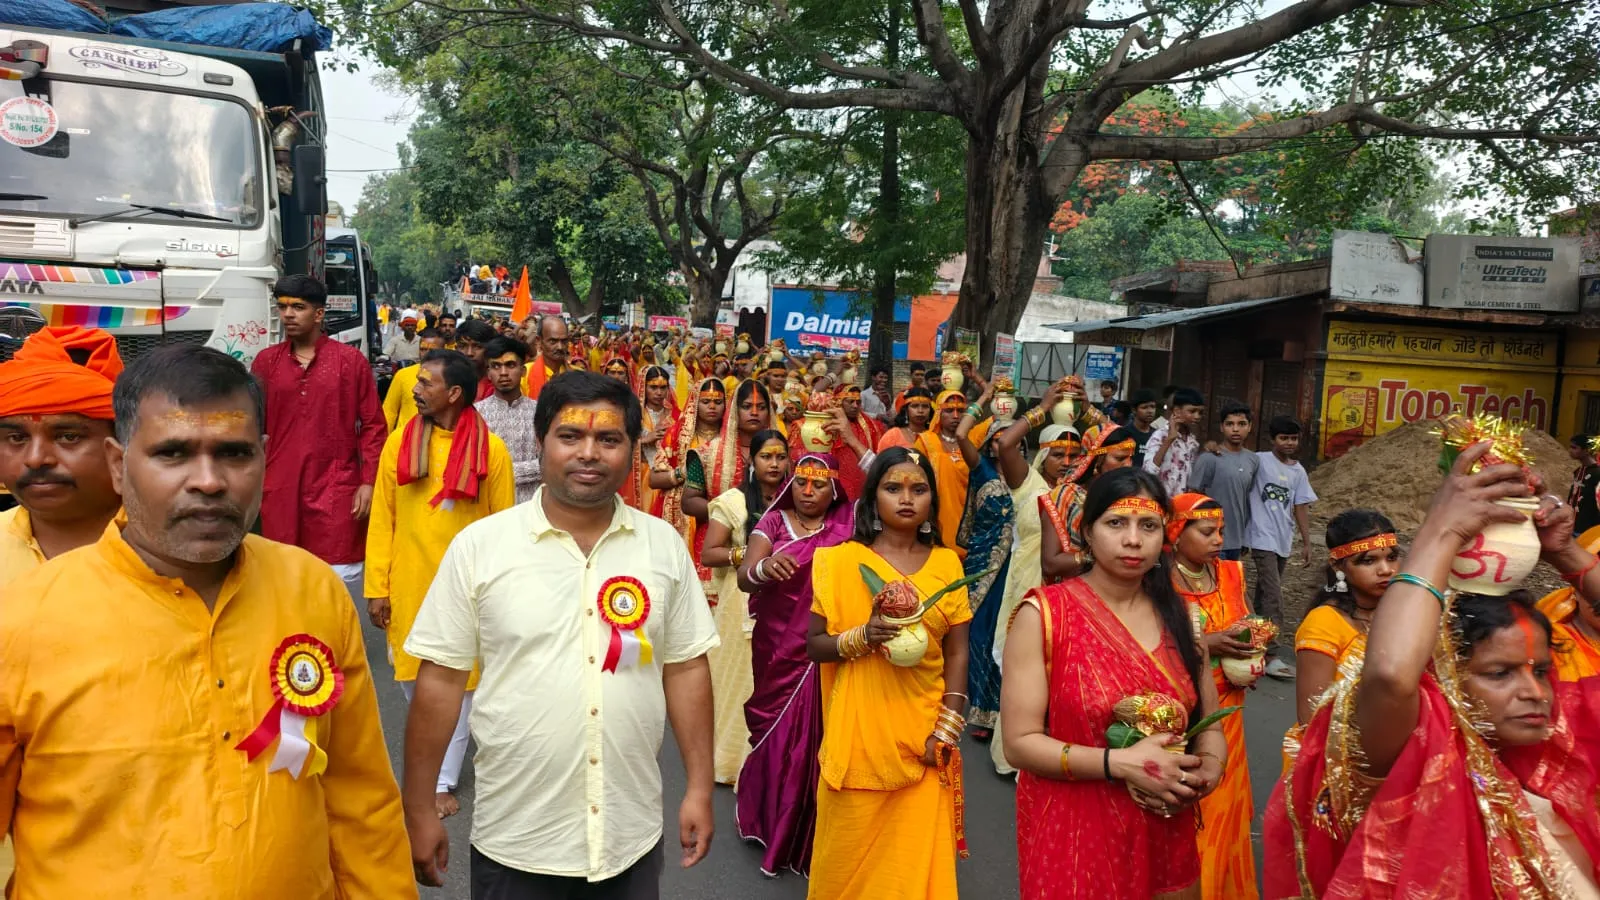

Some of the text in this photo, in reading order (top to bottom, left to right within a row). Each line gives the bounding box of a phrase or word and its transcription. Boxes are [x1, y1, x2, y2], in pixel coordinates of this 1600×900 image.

[80, 48, 158, 70] CARRIER
[31, 124, 43, 133] 154
[1482, 264, 1546, 277] UltraTech
[0, 279, 44, 295] ATA
[784, 311, 872, 336] Dalmia
[1379, 378, 1548, 431] Top-Tech
[1351, 541, 1369, 552] जय
[1373, 535, 1387, 548] श्री
